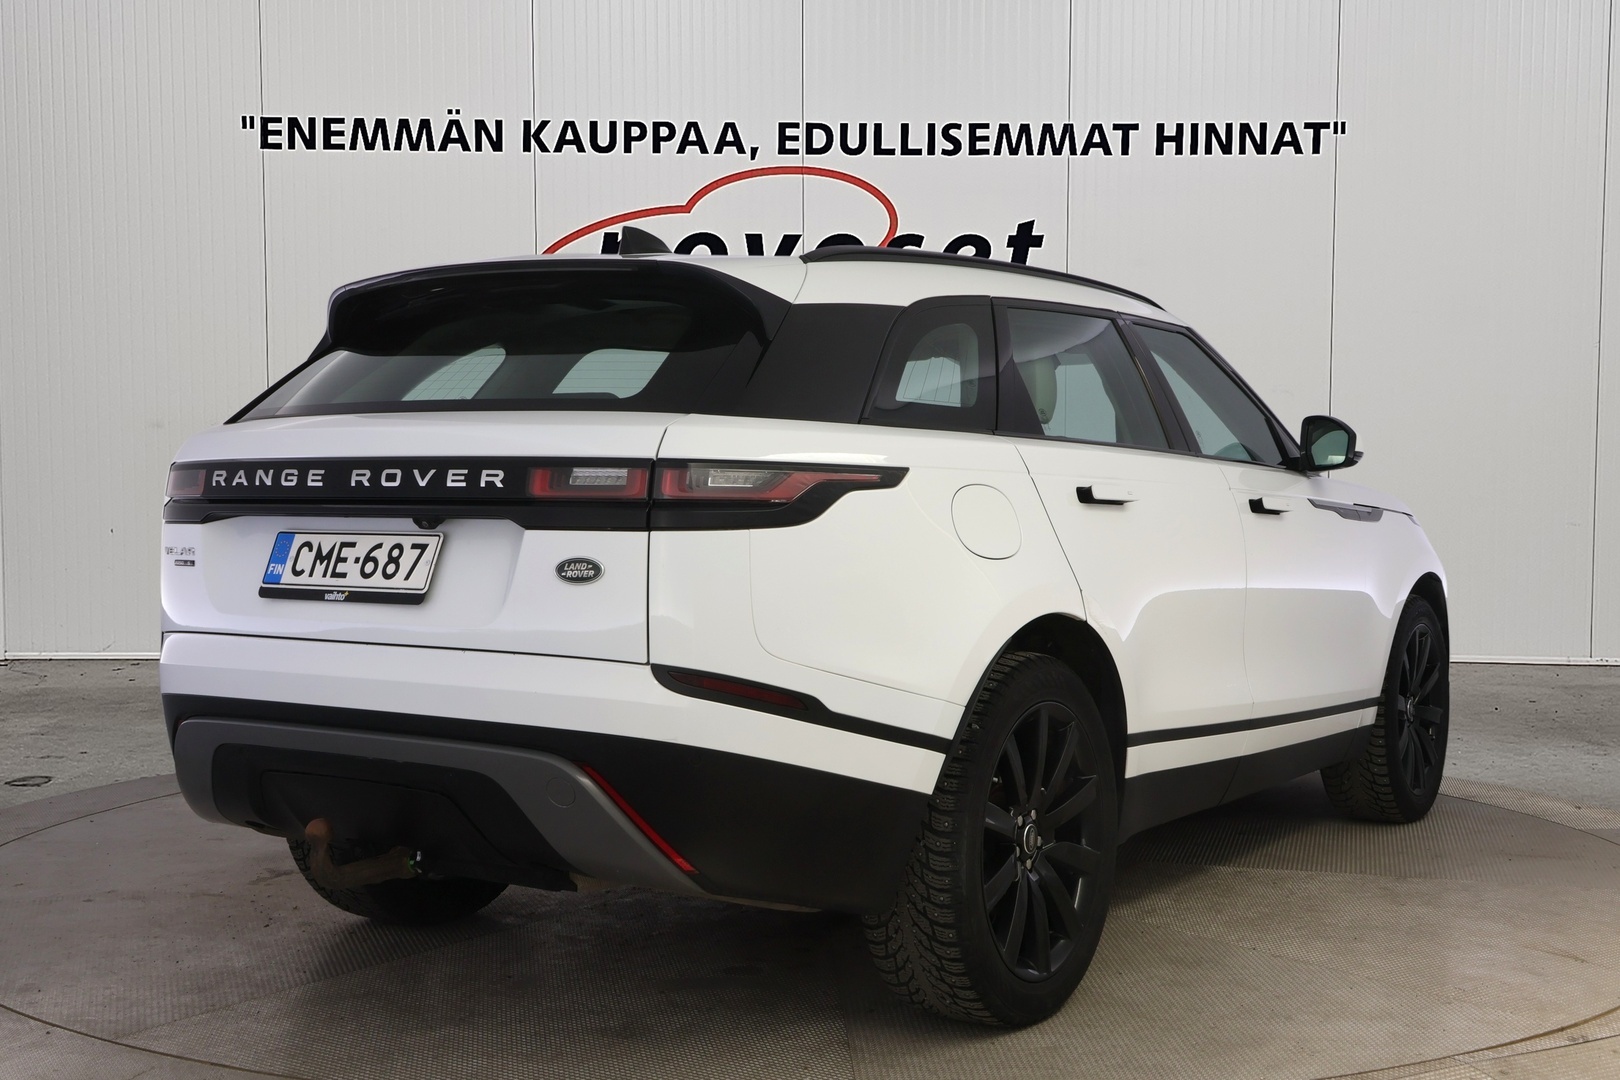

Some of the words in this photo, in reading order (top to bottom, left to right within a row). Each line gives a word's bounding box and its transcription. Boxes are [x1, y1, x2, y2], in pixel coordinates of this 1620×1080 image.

[241, 108, 503, 153] "ENEMMÄN
[522, 119, 759, 161] KAUPPAA,
[777, 122, 1140, 157] EDULLISEMMAT
[1155, 121, 1346, 156] HINNAT"
[212, 469, 325, 487] RANGE
[350, 468, 505, 488] ROVER
[267, 563, 285, 575] FIN
[291, 540, 430, 582] CME-687
